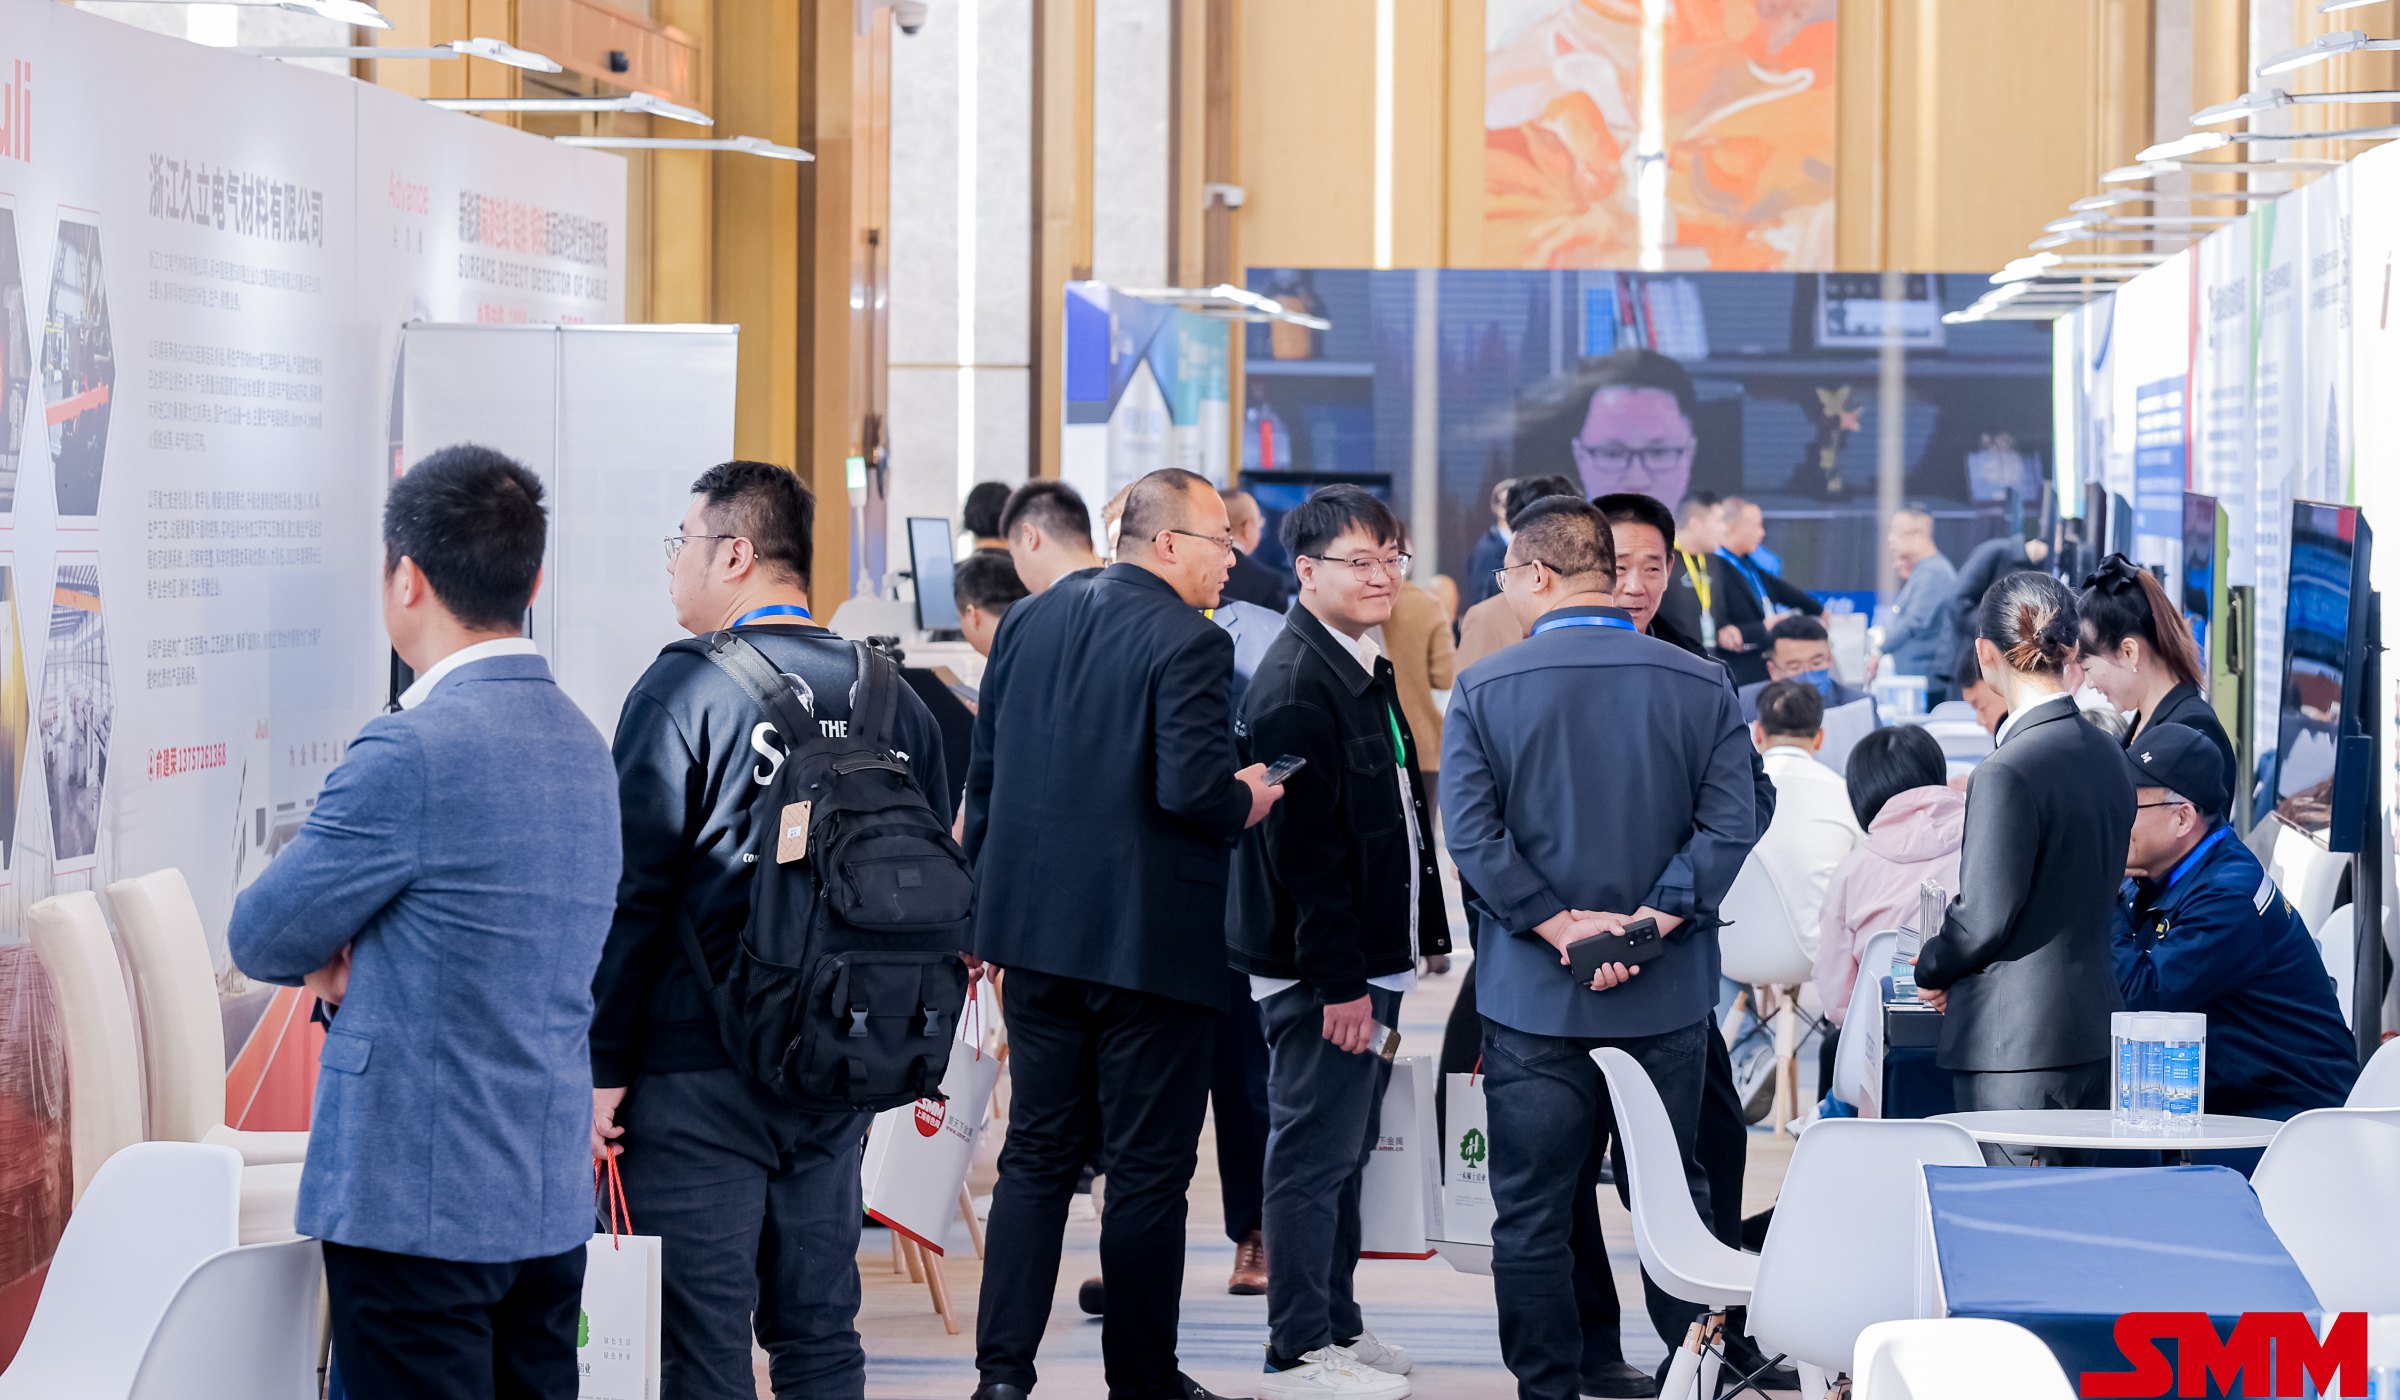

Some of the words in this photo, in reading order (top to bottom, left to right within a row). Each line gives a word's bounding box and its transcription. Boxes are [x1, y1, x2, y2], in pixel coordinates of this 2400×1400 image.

[149, 152, 323, 248] 浙江久立电气材料有限公司
[458, 253, 496, 284] SURFACE
[499, 261, 529, 289] DEFECT
[532, 264, 572, 294] DETECTOR
[574, 273, 584, 297] OF
[586, 275, 609, 301] CABLE
[819, 720, 848, 738] THE
[179, 743, 227, 773] 13757261368
